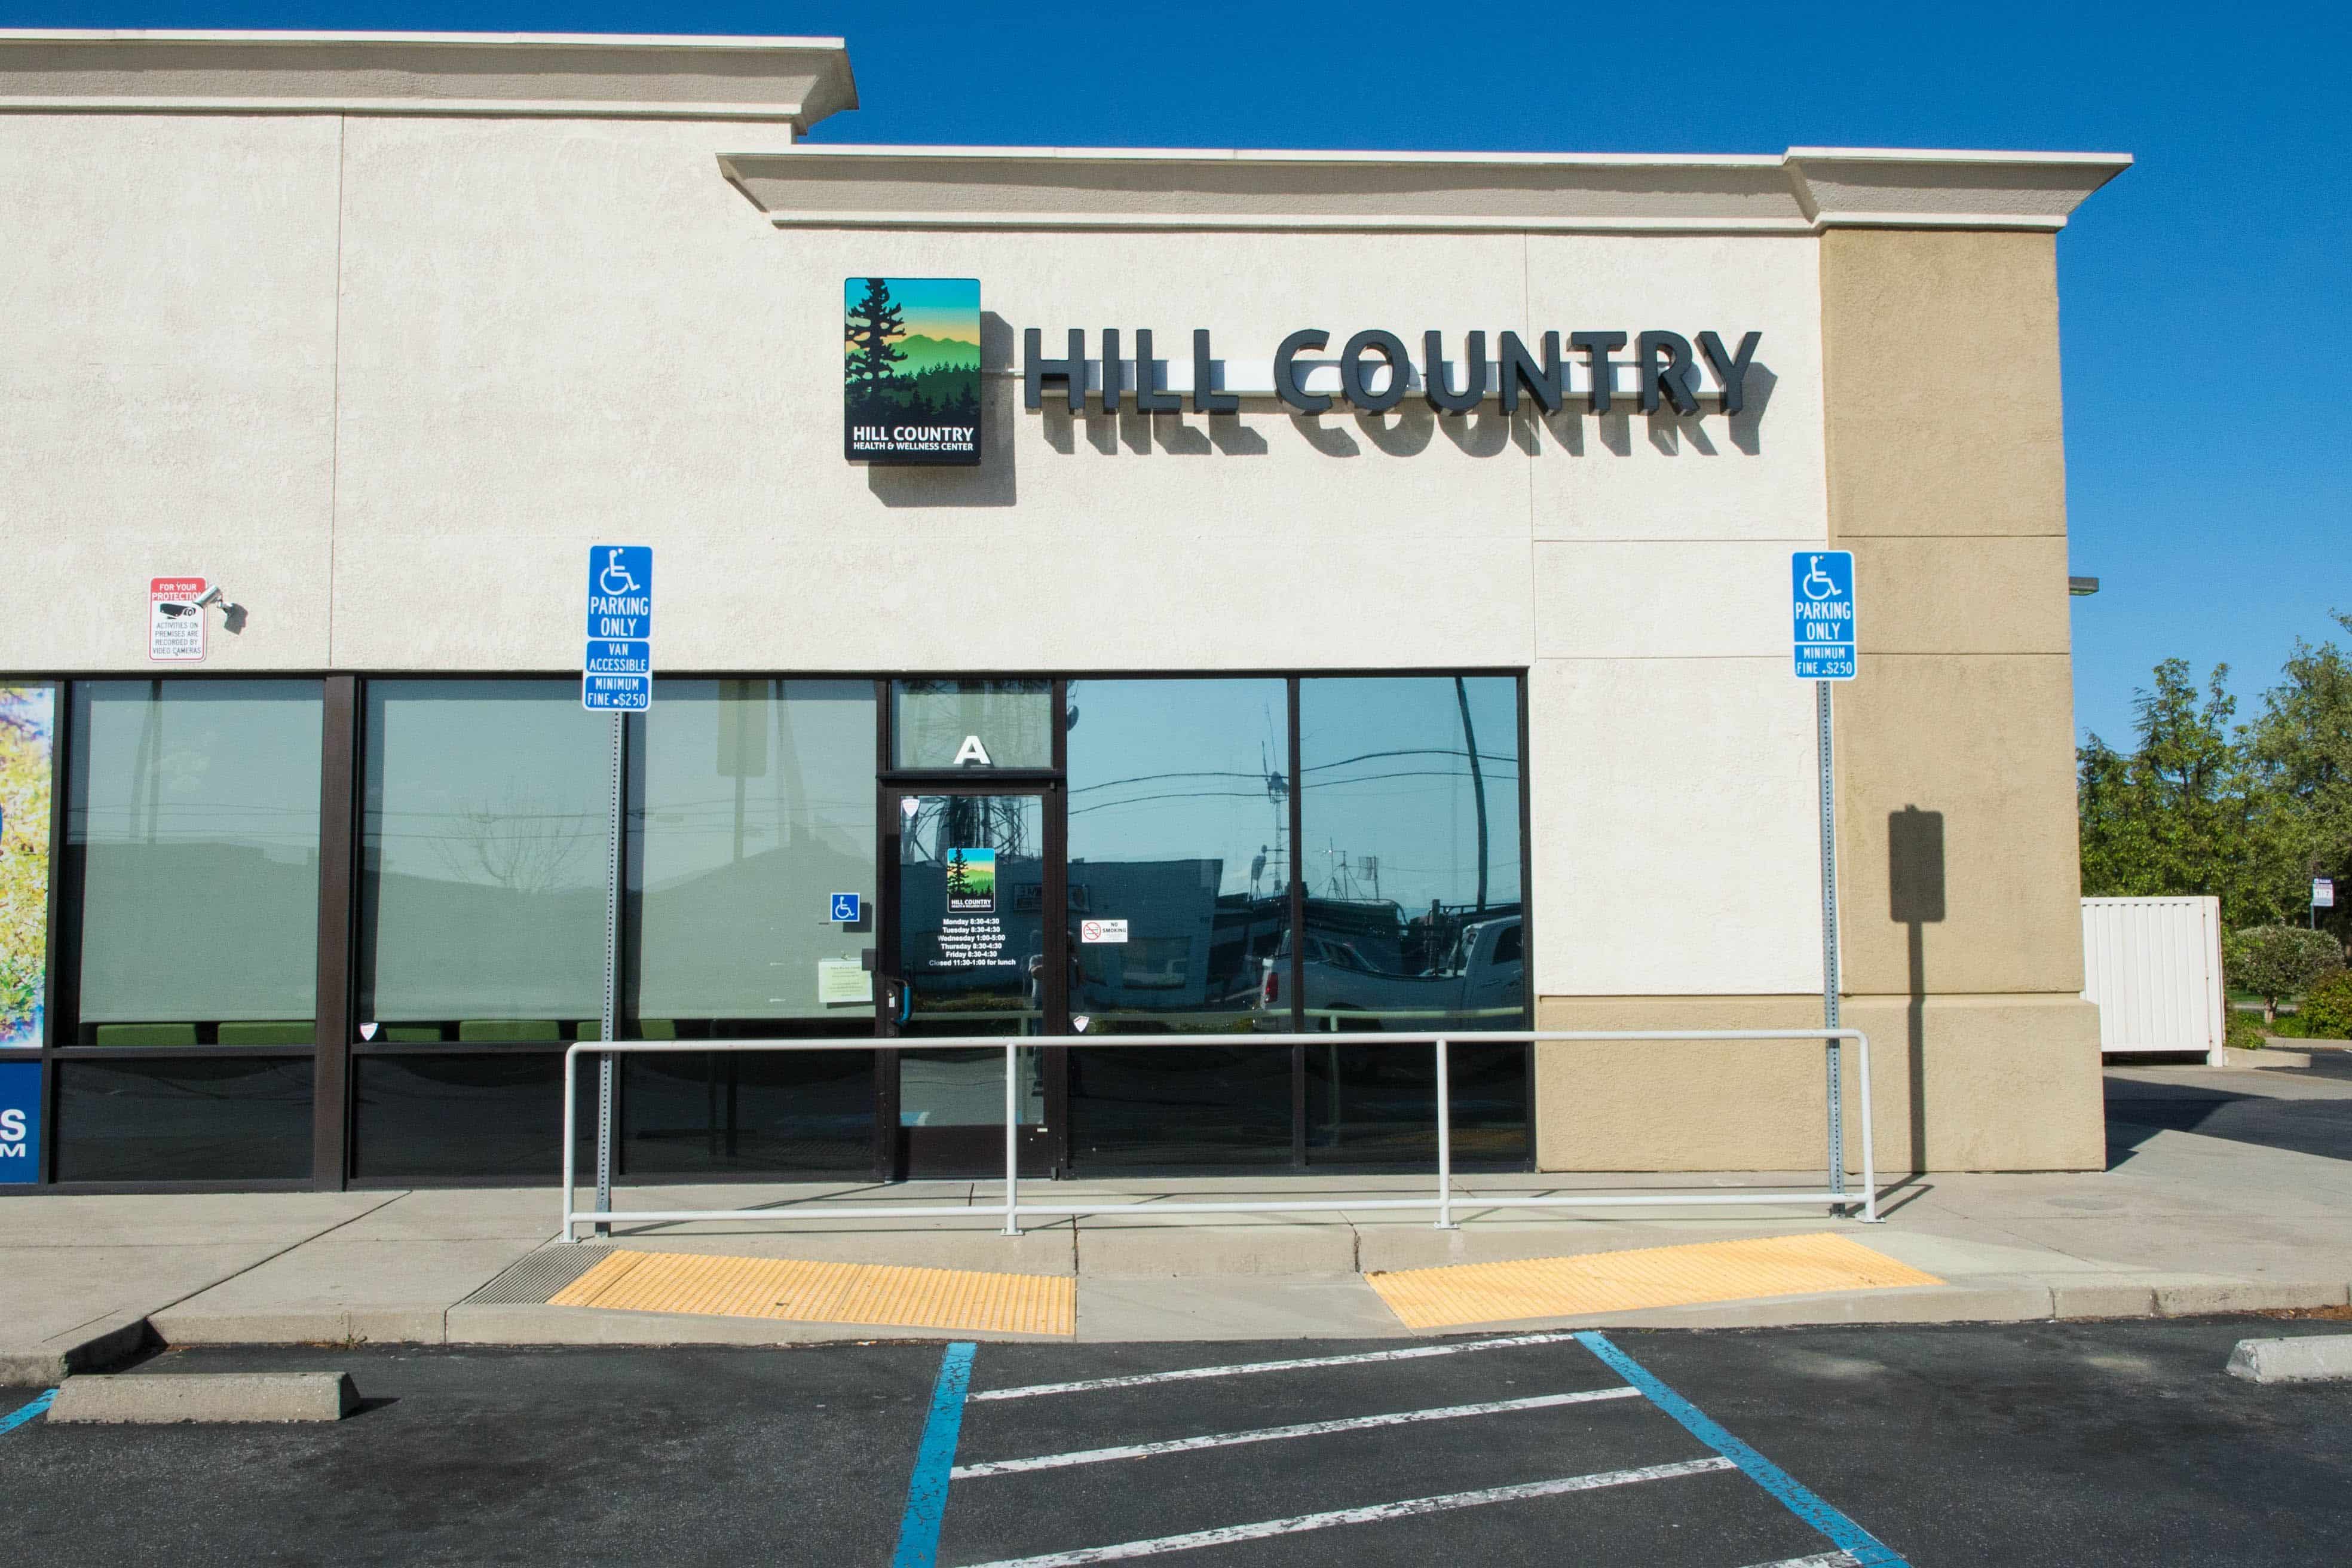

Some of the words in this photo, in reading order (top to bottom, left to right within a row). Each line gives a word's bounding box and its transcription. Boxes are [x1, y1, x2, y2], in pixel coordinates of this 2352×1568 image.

[1025, 328, 1240, 414] HILL
[1273, 328, 1762, 416] COUNTRY
[853, 426, 889, 441] HILL
[893, 426, 974, 442] COUNTRY
[897, 442, 939, 451] WELLNESS
[590, 597, 649, 615] PARKING
[1796, 602, 1851, 619] PARKING
[601, 618, 637, 636] ONLY
[1806, 623, 1840, 640] ONLY
[608, 644, 627, 655] VAN
[1803, 647, 1845, 659] MINIMUM
[589, 659, 646, 672] ACCESSIBLE
[1797, 662, 1818, 674] FINE
[1826, 662, 1852, 674] $250
[595, 678, 639, 691] MINIMUM
[587, 693, 609, 705] FINE
[618, 693, 646, 707] $250
[953, 736, 991, 764] A
